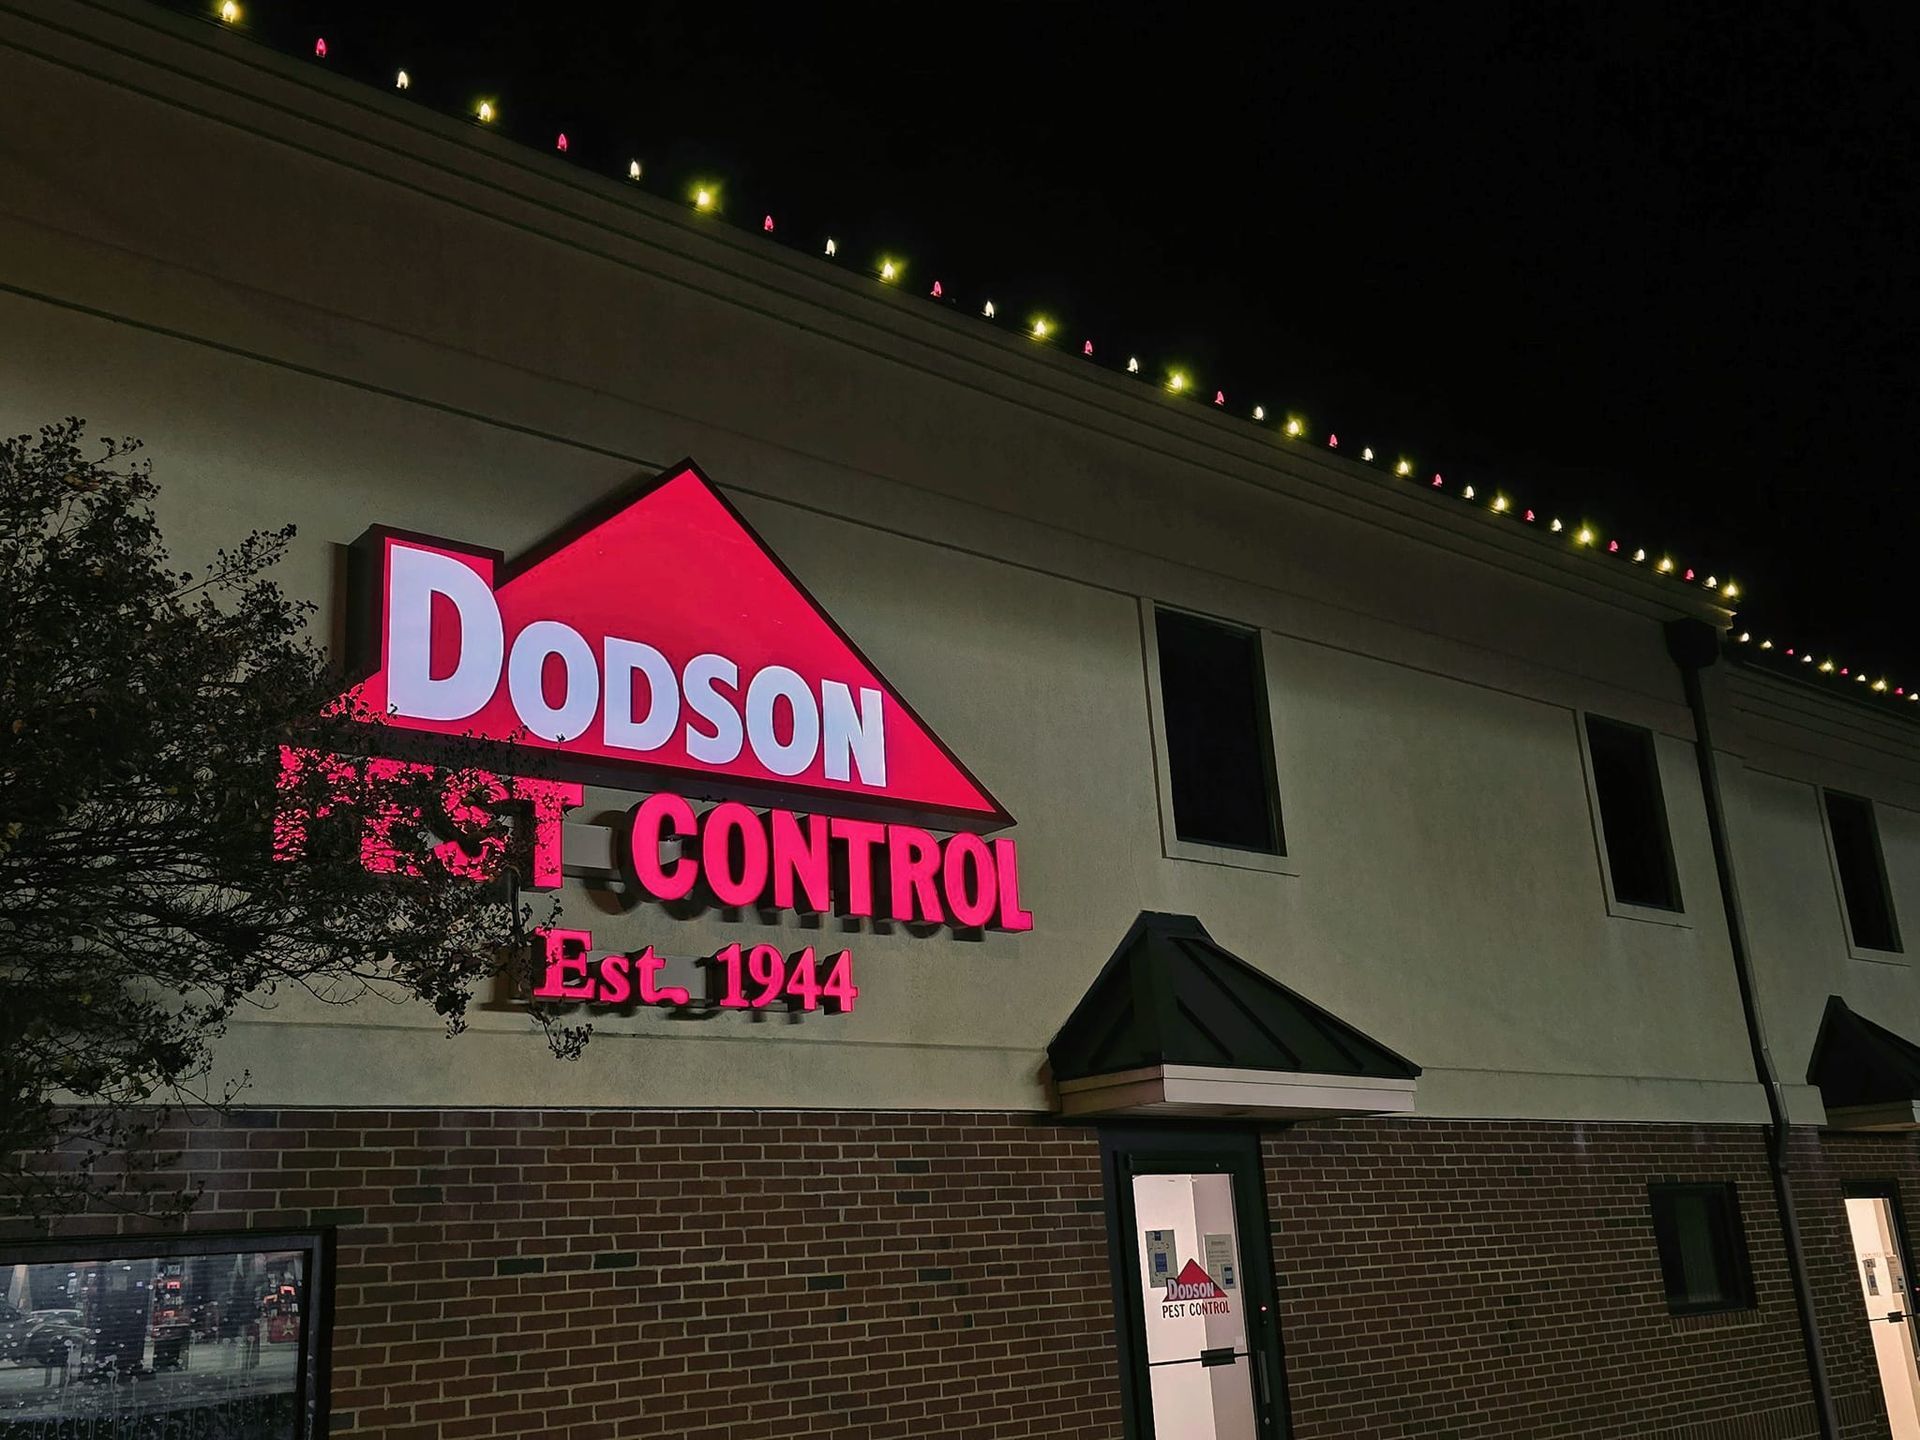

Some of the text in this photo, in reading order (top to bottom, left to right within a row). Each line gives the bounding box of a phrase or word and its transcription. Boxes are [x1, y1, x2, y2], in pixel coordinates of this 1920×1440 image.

[386, 543, 887, 788] DODSON
[631, 792, 1034, 932] CONTROL
[533, 927, 857, 1012] Est. 1944
[1162, 1301, 1230, 1318] PEST CONTROL
[1167, 1279, 1214, 1299] DODSON
